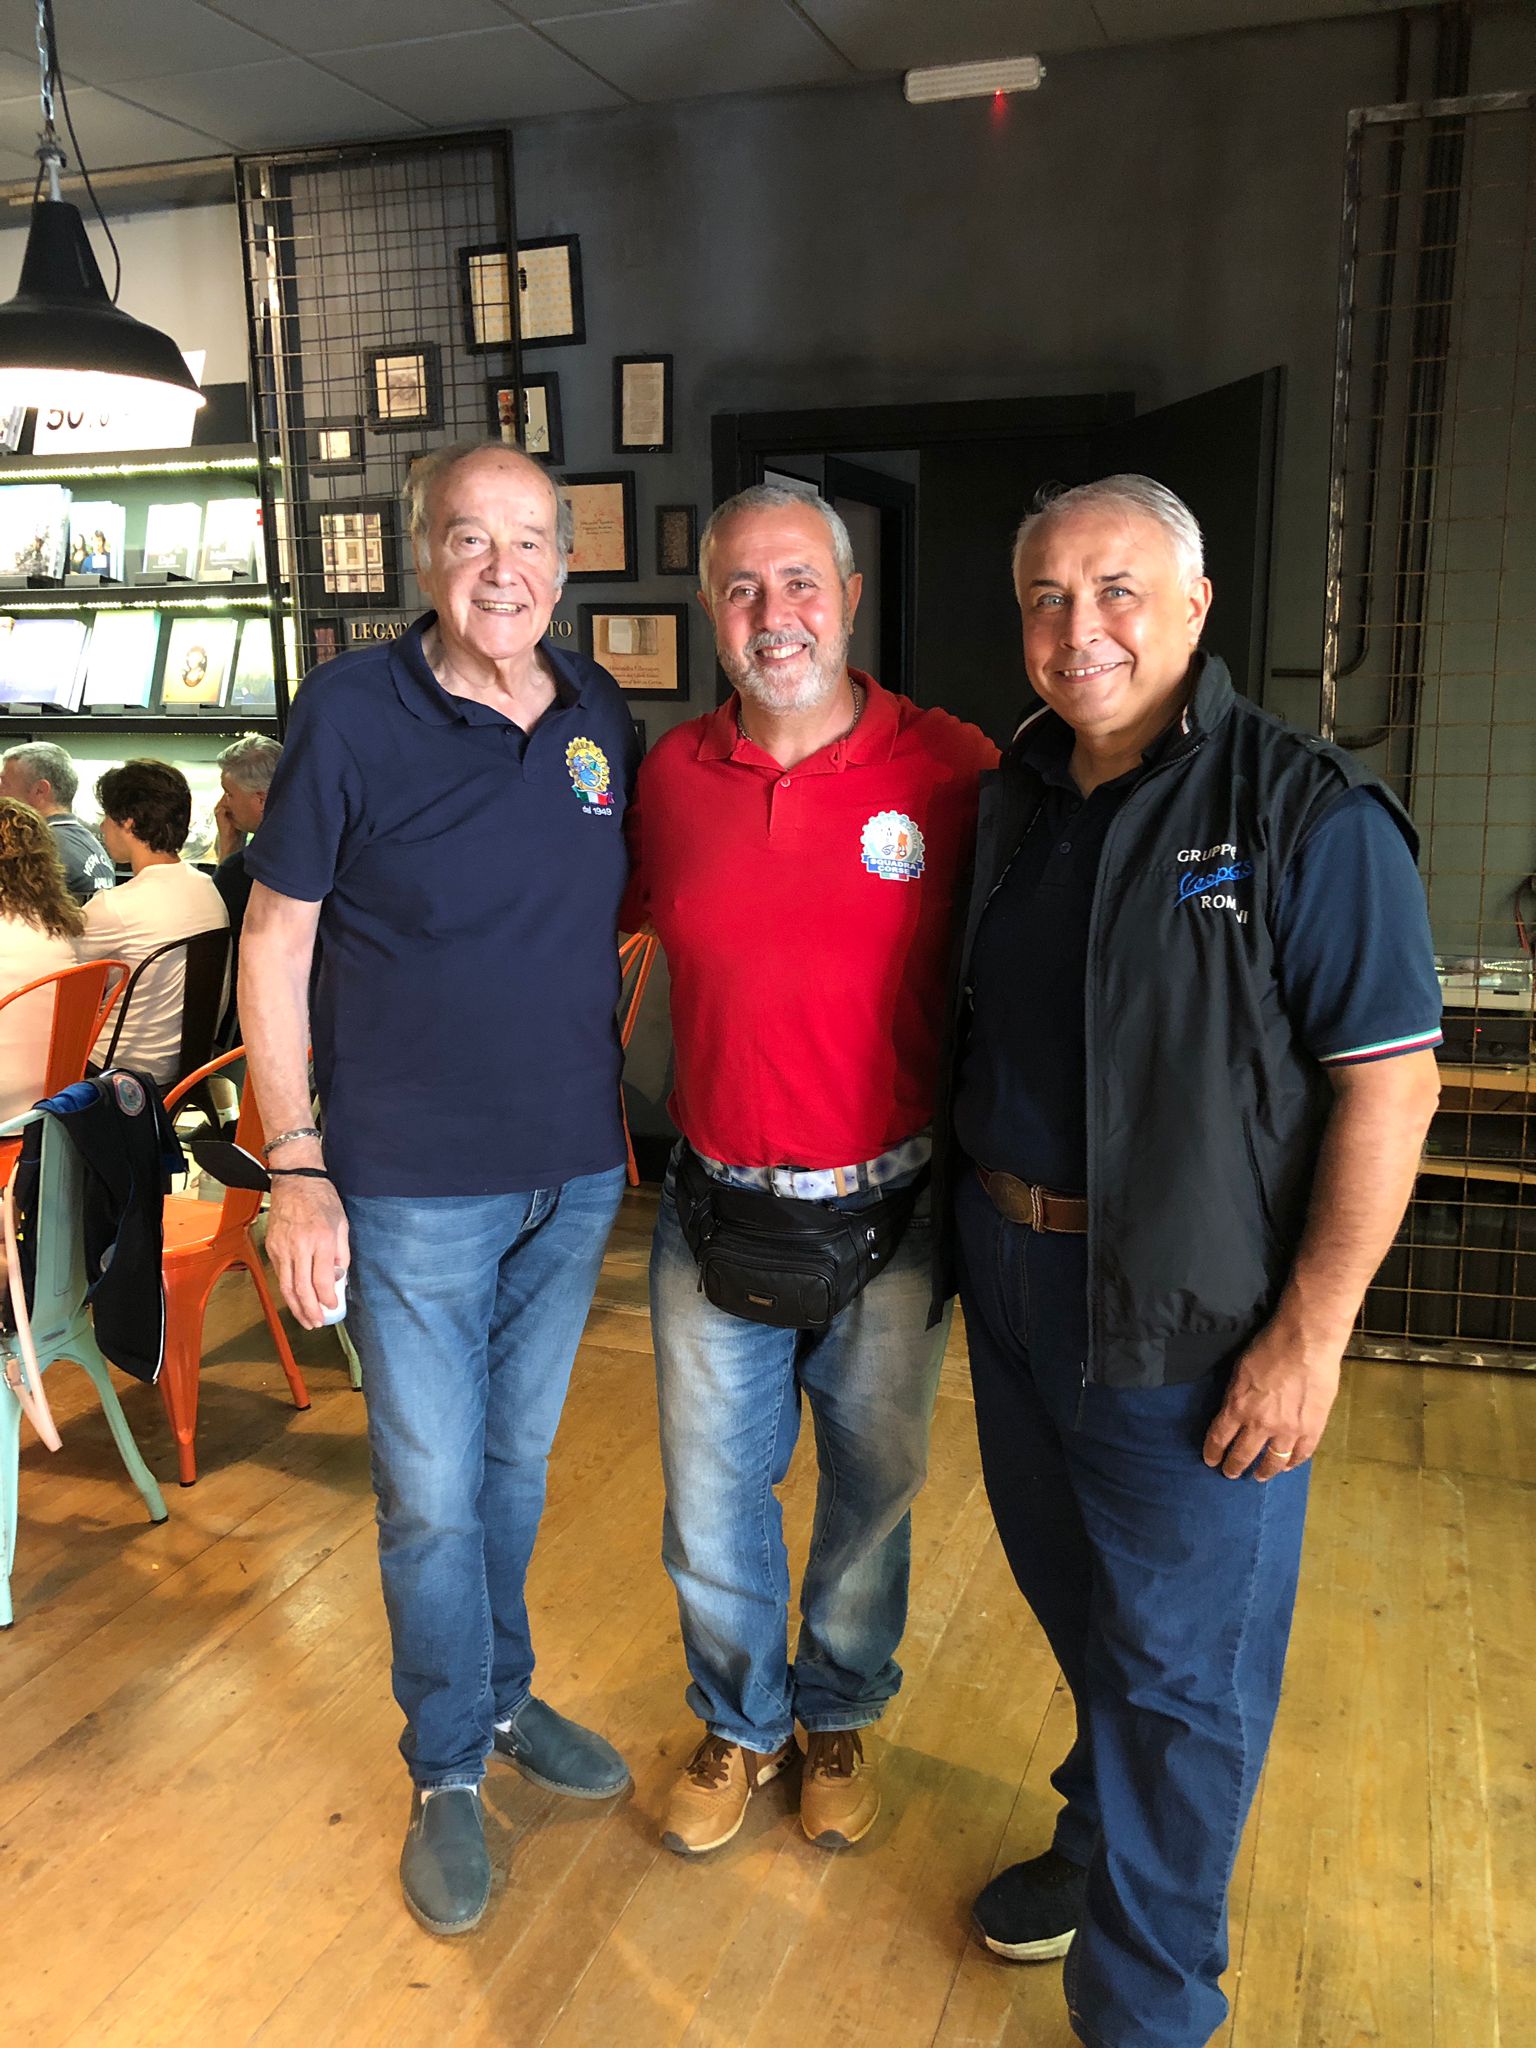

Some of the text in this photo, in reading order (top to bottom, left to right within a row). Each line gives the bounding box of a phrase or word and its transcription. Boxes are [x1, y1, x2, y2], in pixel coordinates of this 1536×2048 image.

[351, 620, 573, 640] LEGAT TO
[592, 807, 612, 816] 1949
[870, 858, 917, 870] SQUADRA
[877, 866, 910, 875] CORSE
